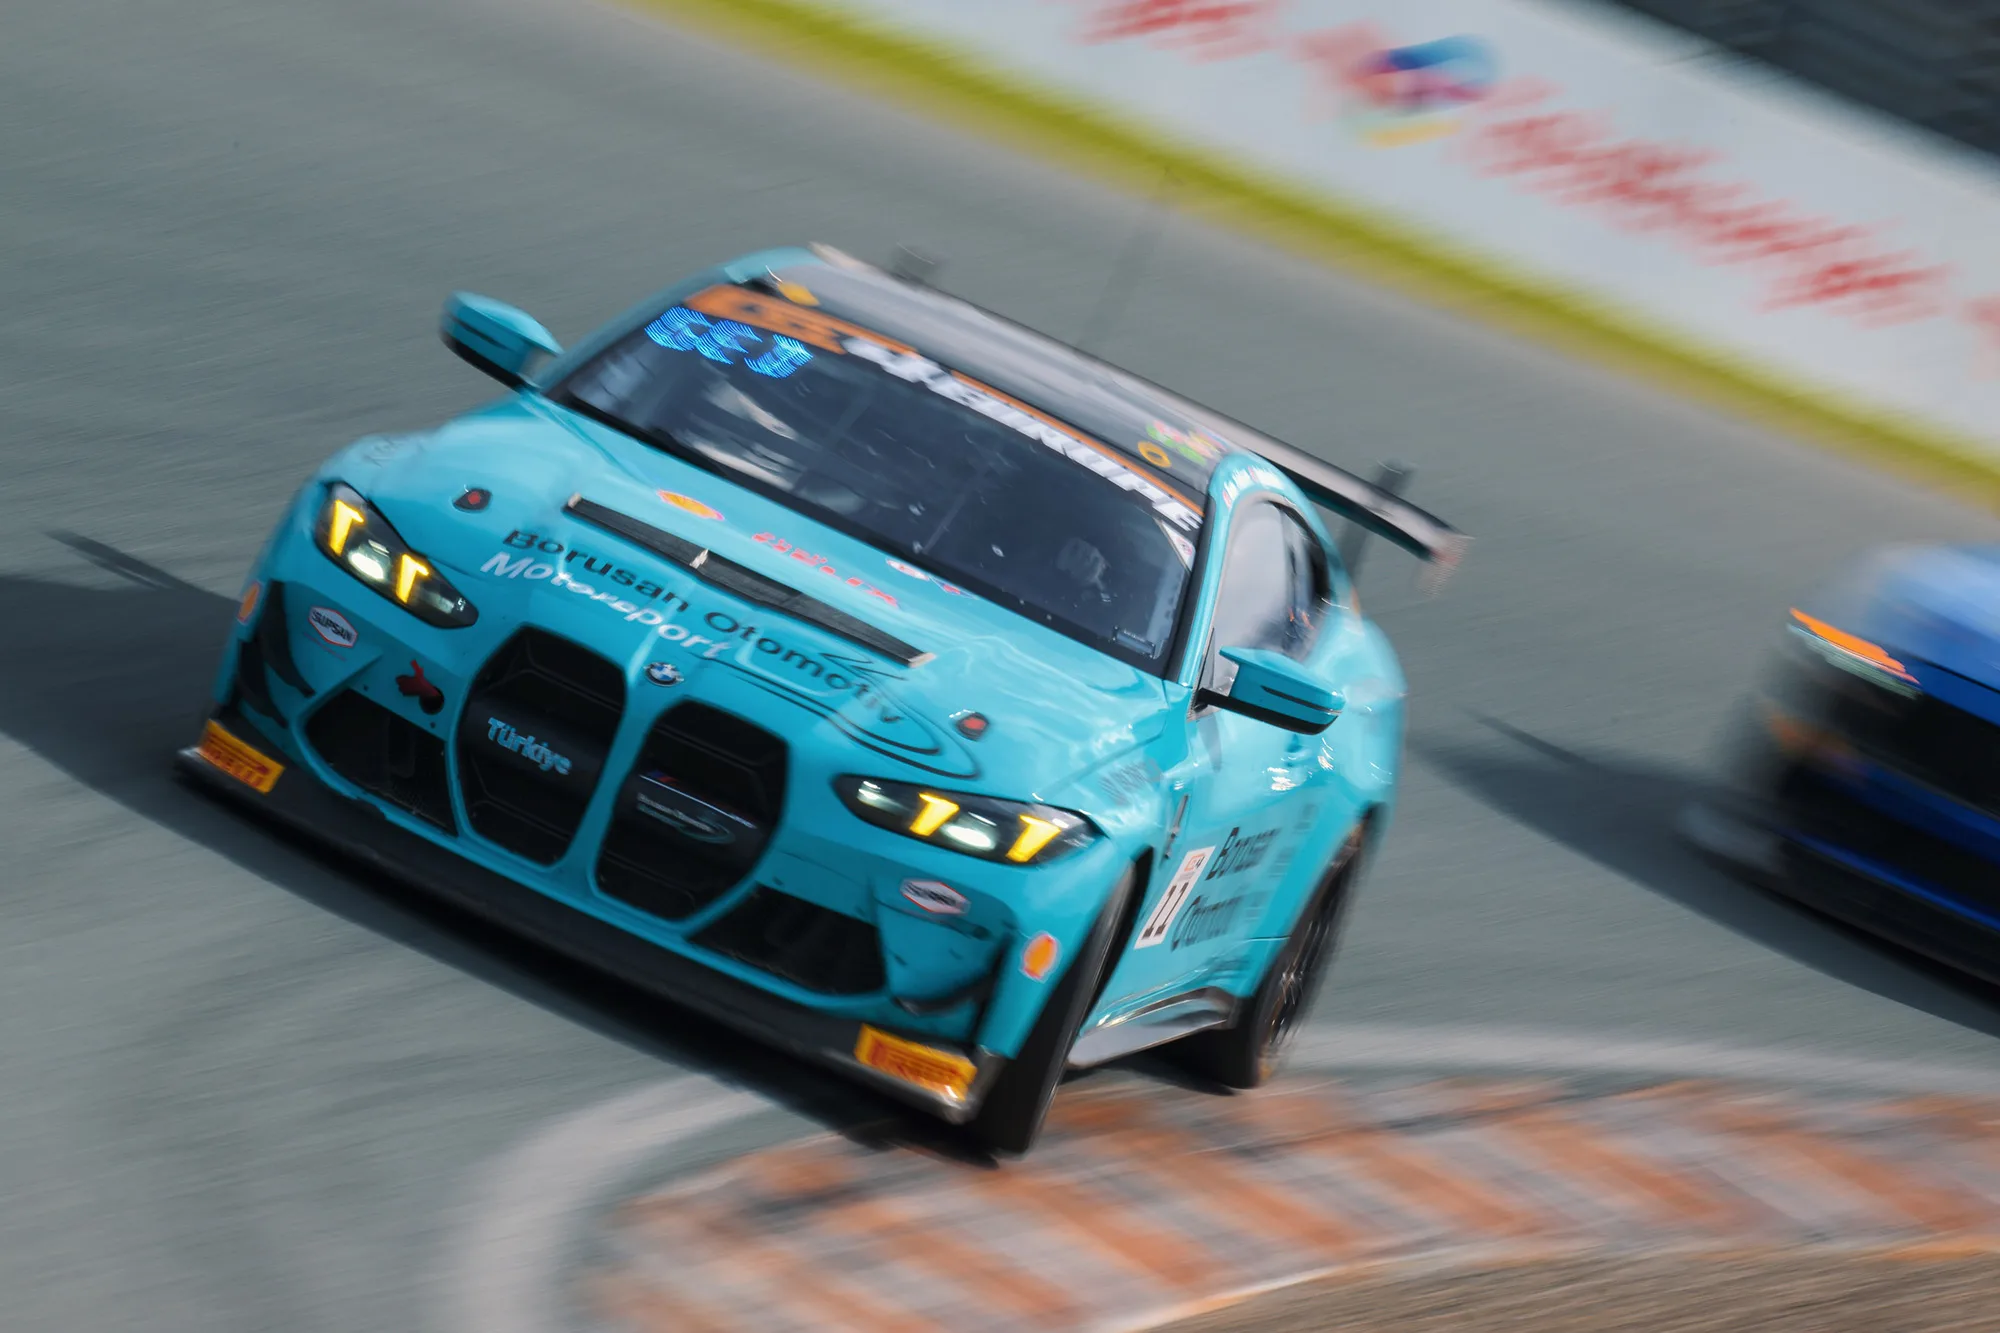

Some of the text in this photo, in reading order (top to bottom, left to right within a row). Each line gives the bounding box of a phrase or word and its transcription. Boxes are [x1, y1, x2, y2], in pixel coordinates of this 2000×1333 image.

[480, 552, 731, 658] Motorsport
[503, 529, 689, 612] Borusan
[704, 612, 901, 724] Otomotiv
[488, 717, 572, 775] Türkiye
[1142, 882, 1189, 939] 11
